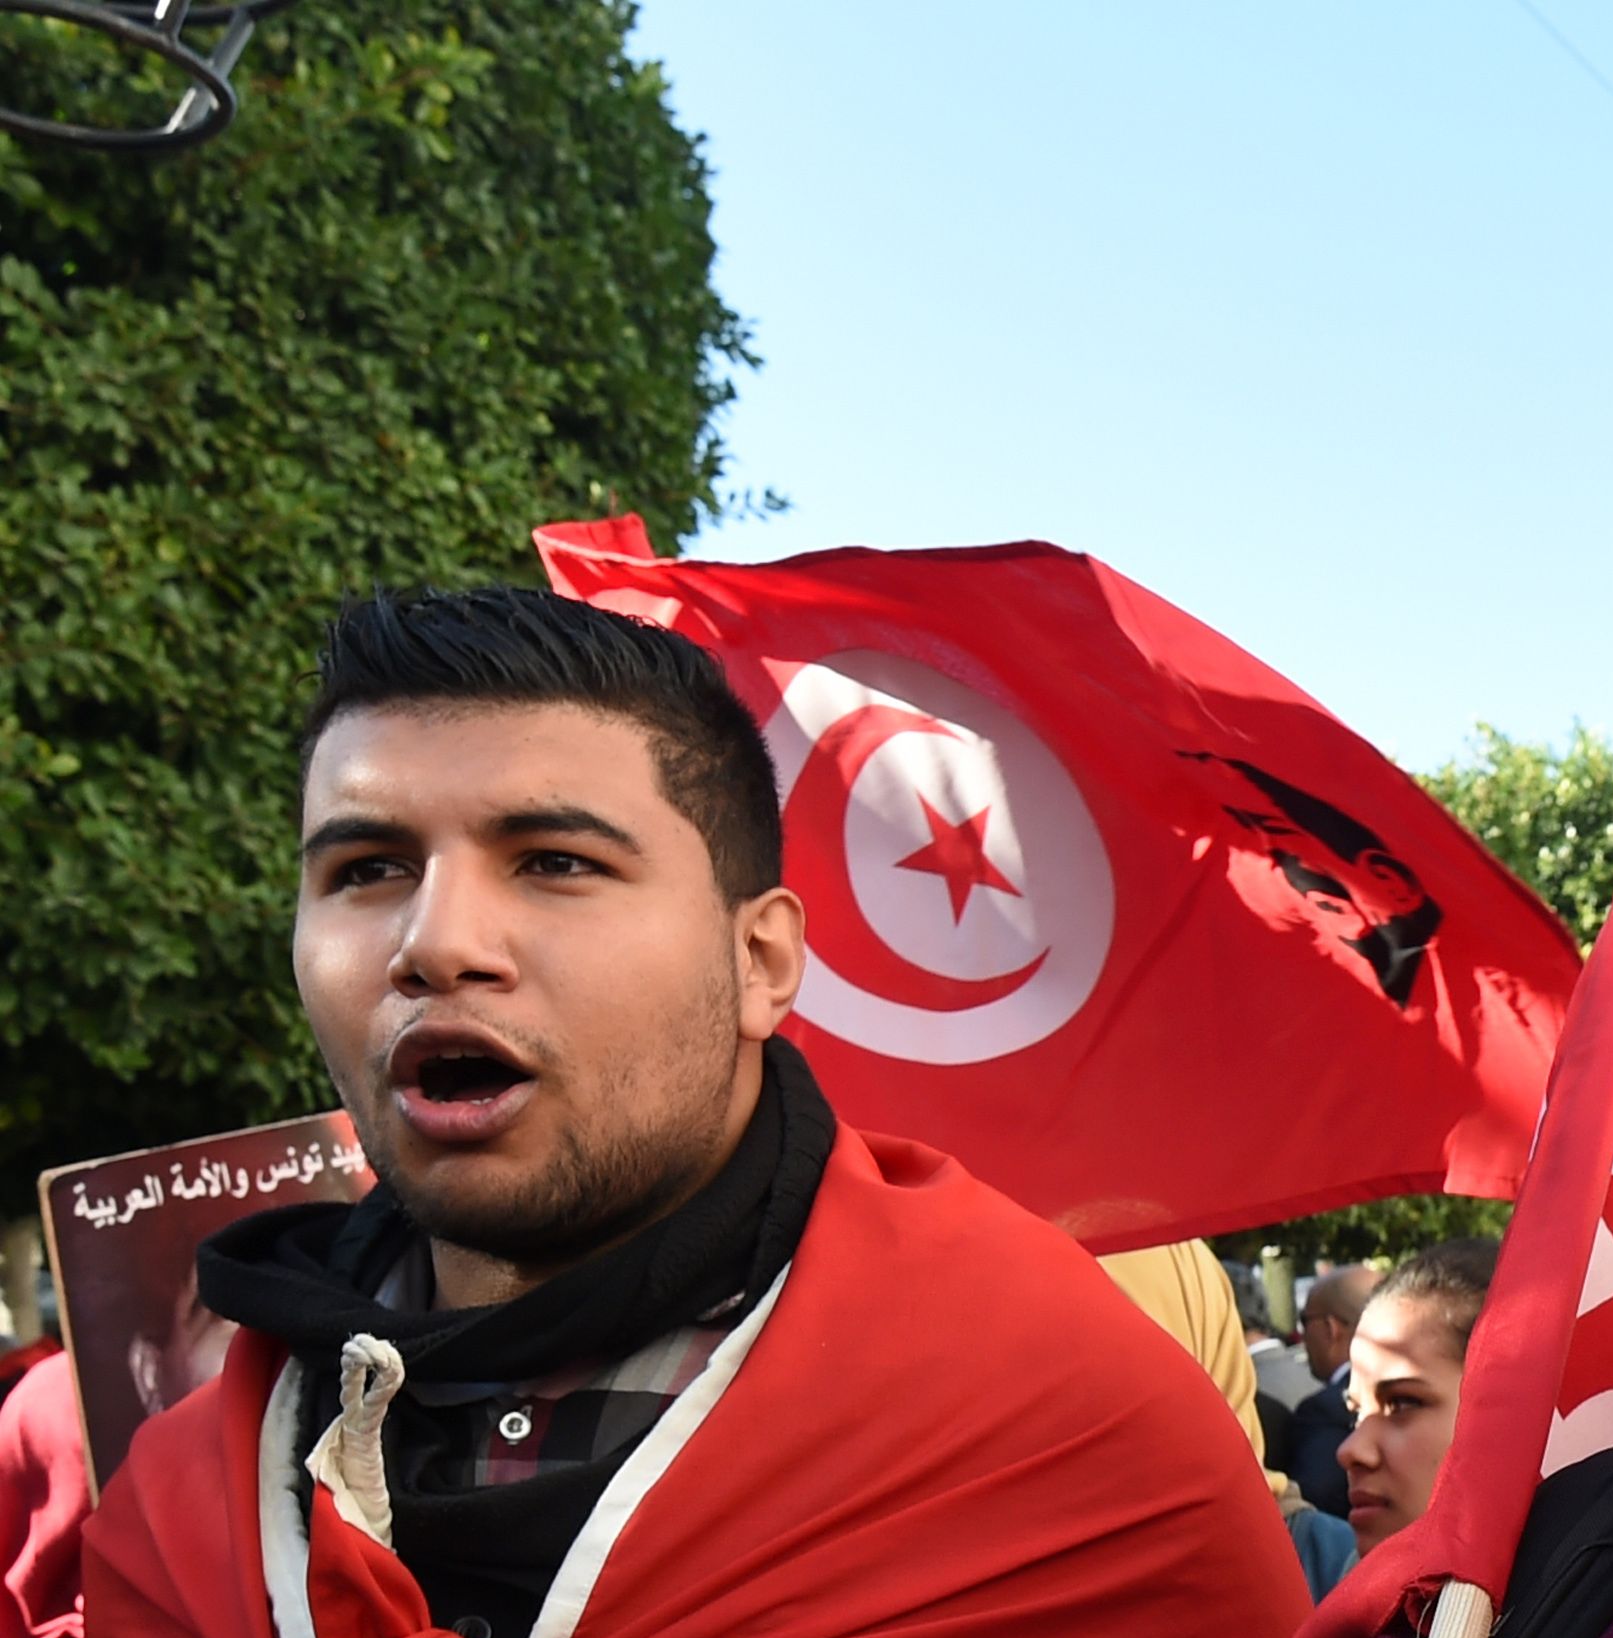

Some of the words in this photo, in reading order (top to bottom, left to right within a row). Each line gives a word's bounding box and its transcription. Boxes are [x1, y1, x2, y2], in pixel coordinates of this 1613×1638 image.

[171, 1157, 249, 1199] والأمة
[256, 1142, 324, 1193] تونس
[73, 1174, 164, 1228] العربية
